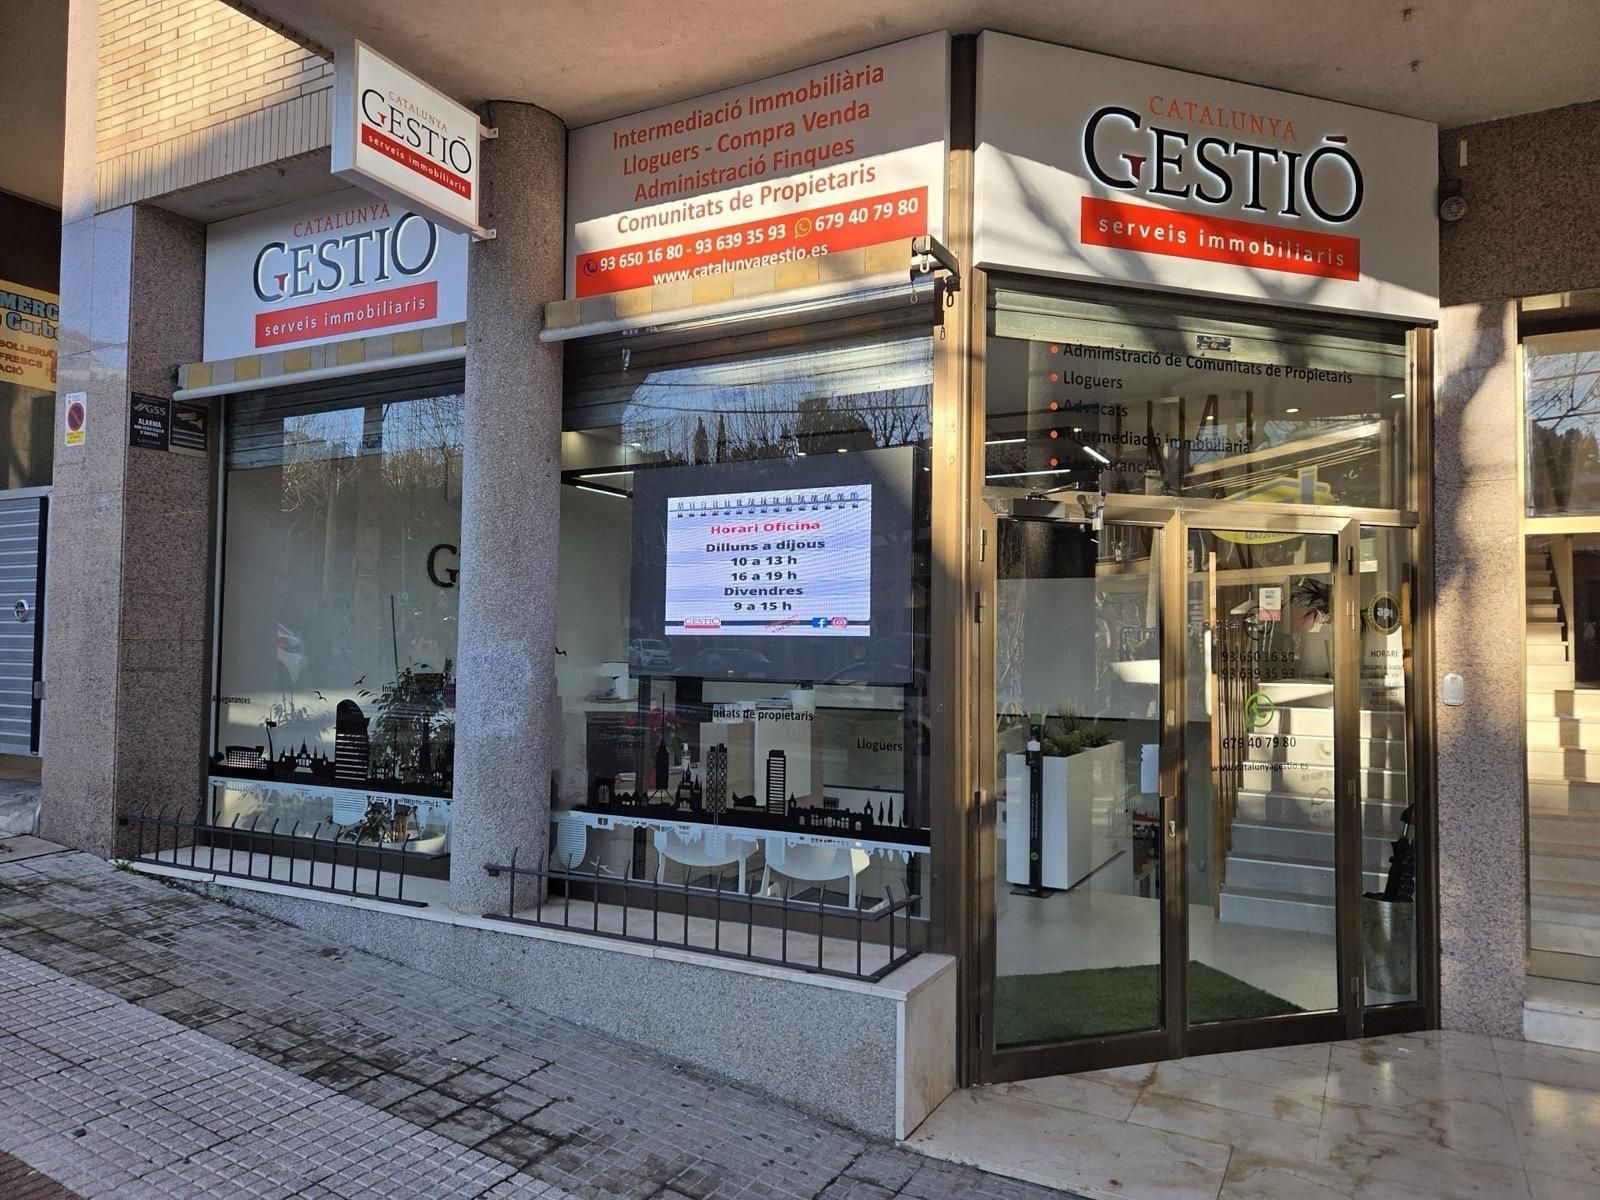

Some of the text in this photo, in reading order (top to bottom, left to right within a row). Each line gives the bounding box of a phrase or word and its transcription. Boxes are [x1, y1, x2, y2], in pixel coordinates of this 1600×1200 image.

[389, 91, 447, 133] CATALUNYA
[613, 65, 884, 150] Intermediació Immobiliària
[1149, 95, 1297, 141] CATALUNYA
[362, 89, 472, 174] GESTIÓ
[623, 144, 700, 176] Lloguers
[717, 121, 795, 153] Compra
[802, 101, 870, 133] Venda
[368, 135, 466, 192] serveis immobiliaris
[634, 139, 855, 202] Administració Finques
[1083, 105, 1364, 224] GESTIÓ
[617, 163, 876, 234] Comunitats de Propietaris
[293, 202, 391, 238] CATALUNYA
[815, 197, 919, 232] 679 40 79 80
[600, 257, 616, 272] 93
[619, 253, 643, 269] 650
[647, 248, 663, 263] 16
[666, 243, 683, 260] 80
[695, 239, 713, 255] 93
[716, 232, 742, 251] 639
[746, 227, 764, 245] 35
[768, 223, 786, 242] 93
[1099, 217, 1345, 267] serveis immobiliaris
[264, 296, 426, 338] serveis immobiliaris
[1063, 343, 1353, 384] Administració de Comunitats de Propietaris
[1063, 370, 1123, 390] Lloguers
[1063, 399, 1128, 417] Advocats
[1166, 434, 1250, 454] immobiliària
[711, 521, 820, 534] Horari Oficina
[706, 542, 758, 552] Dilluns
[776, 540, 825, 551] dijous
[731, 557, 747, 566] 10
[766, 556, 782, 565] 13
[788, 555, 797, 564] h
[731, 572, 747, 581] 16
[766, 571, 782, 580] 19
[788, 571, 797, 580] h
[724, 586, 803, 596] Divendres
[734, 602, 742, 610] 9
[761, 602, 777, 610] 15
[783, 601, 791, 610] h
[1222, 650, 1235, 662] 93
[1264, 650, 1277, 661] 16
[1281, 650, 1295, 662] 80
[1371, 650, 1398, 658] HORARI
[1222, 667, 1235, 679] 93
[1264, 668, 1278, 678] 35
[1281, 668, 1295, 678] 93
[743, 707, 755, 719] de
[758, 709, 814, 721] propietaris
[856, 738, 904, 752] Lloguers
[1222, 736, 1296, 749] 679 40 79 80
